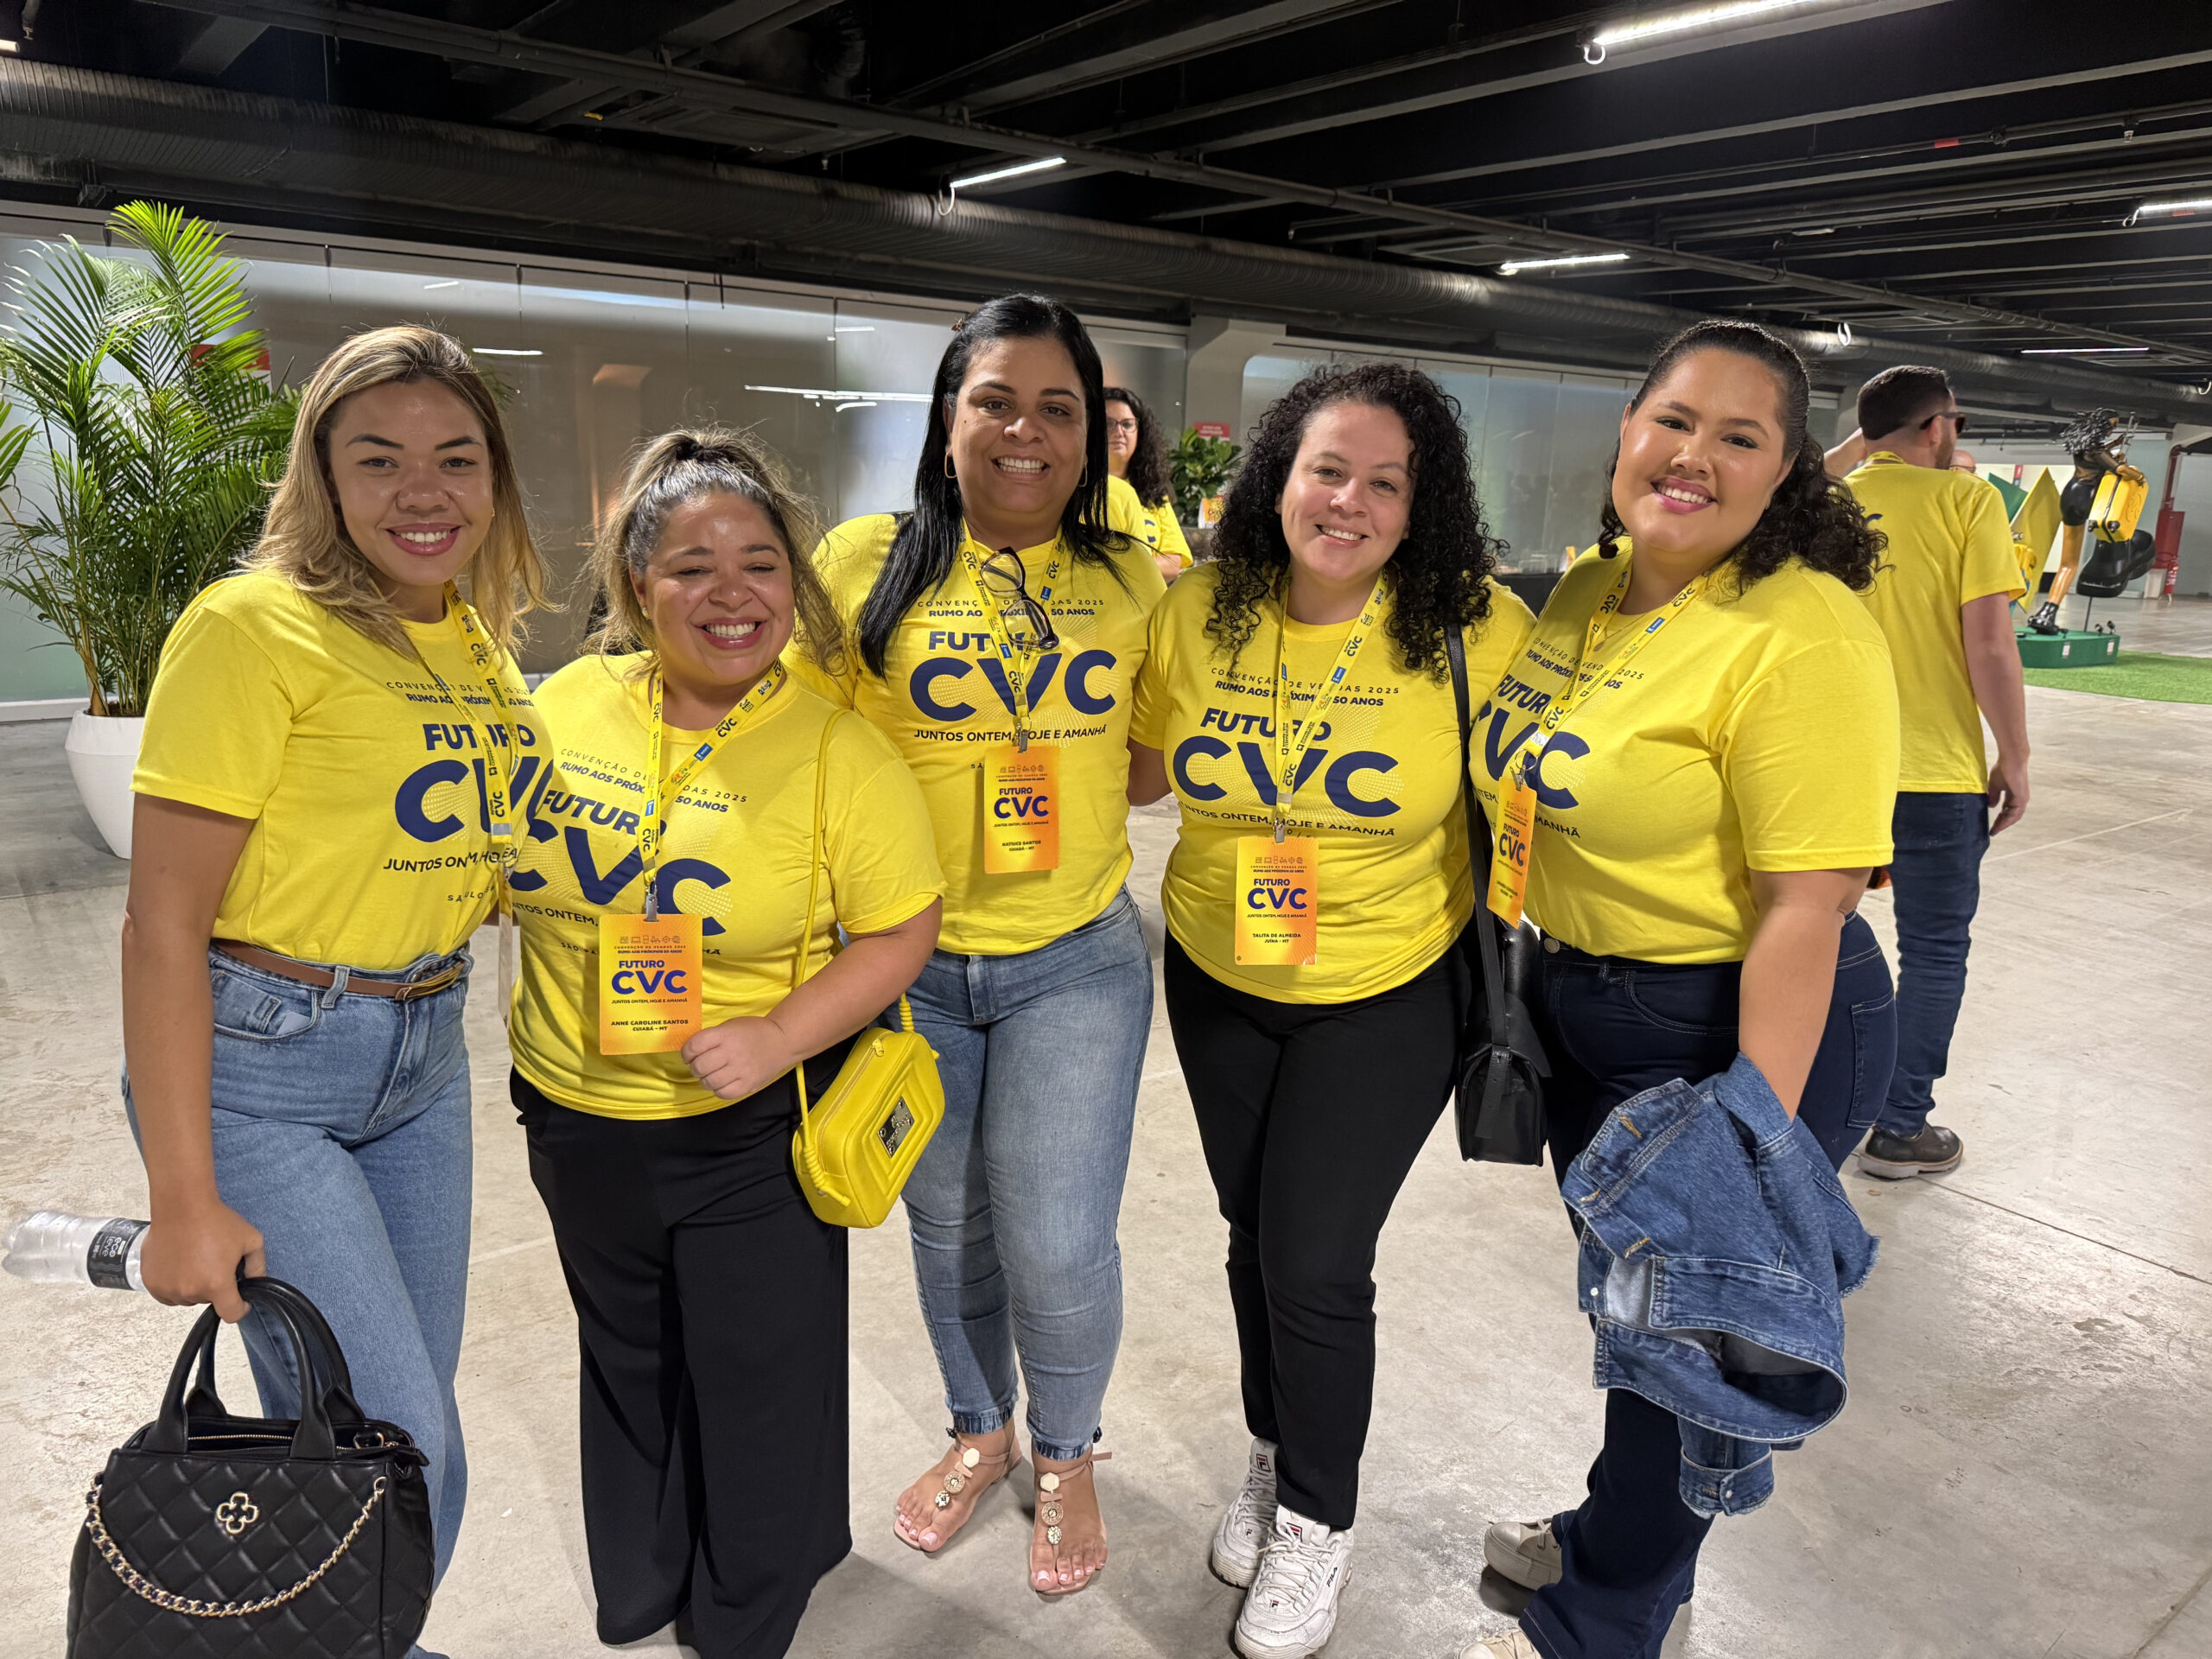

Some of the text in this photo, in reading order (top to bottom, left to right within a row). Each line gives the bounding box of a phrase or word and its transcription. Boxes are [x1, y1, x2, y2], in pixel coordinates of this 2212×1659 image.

[963, 551, 976, 570] CVC
[1048, 561, 1060, 580] CVC
[1600, 594, 1617, 614] CVC
[1673, 588, 1695, 607] CVC
[1346, 636, 1363, 657] CVC
[1539, 658, 1553, 670] AOS
[1582, 661, 1604, 671] VEND
[1618, 669, 1644, 680] 2025
[910, 650, 1117, 721] CVC
[1008, 671, 1021, 693] CVC
[406, 693, 438, 703] RUMO
[441, 696, 454, 705] AO
[1215, 681, 1246, 693] RUMO
[1247, 688, 1270, 697] AOS
[1350, 697, 1383, 706] ANOS
[717, 717, 738, 738] CVC
[1545, 706, 1565, 730] CVC
[914, 724, 1107, 743] JUNTOS ONTEM, OJE E AMANHÃ
[1478, 700, 1591, 809] VC
[561, 748, 628, 773] CONVENÇÃO
[715, 791, 747, 803] 2025
[1173, 735, 1402, 817] CVC
[1285, 764, 1297, 786] CVC
[560, 761, 589, 776] RUMO
[588, 770, 614, 784] AOS
[675, 796, 692, 805] 50
[692, 799, 729, 813] ANOS
[999, 787, 1033, 796] FUTURO
[493, 791, 505, 817] CVC
[994, 796, 1049, 818] CVC
[1221, 811, 1273, 826] ONTEM,
[1328, 823, 1395, 836] AMANHÃ
[1503, 823, 1520, 837] FUTURO
[1535, 815, 1581, 838] MANHÃ
[1499, 833, 1526, 867] CVC
[384, 858, 442, 872] JUNTOS
[1248, 888, 1307, 910] CVC
[544, 908, 599, 928] ONTEM,
[619, 960, 665, 969] FUTURO
[611, 969, 688, 995] CVC
[1326, 1567, 1338, 1588] FILA
